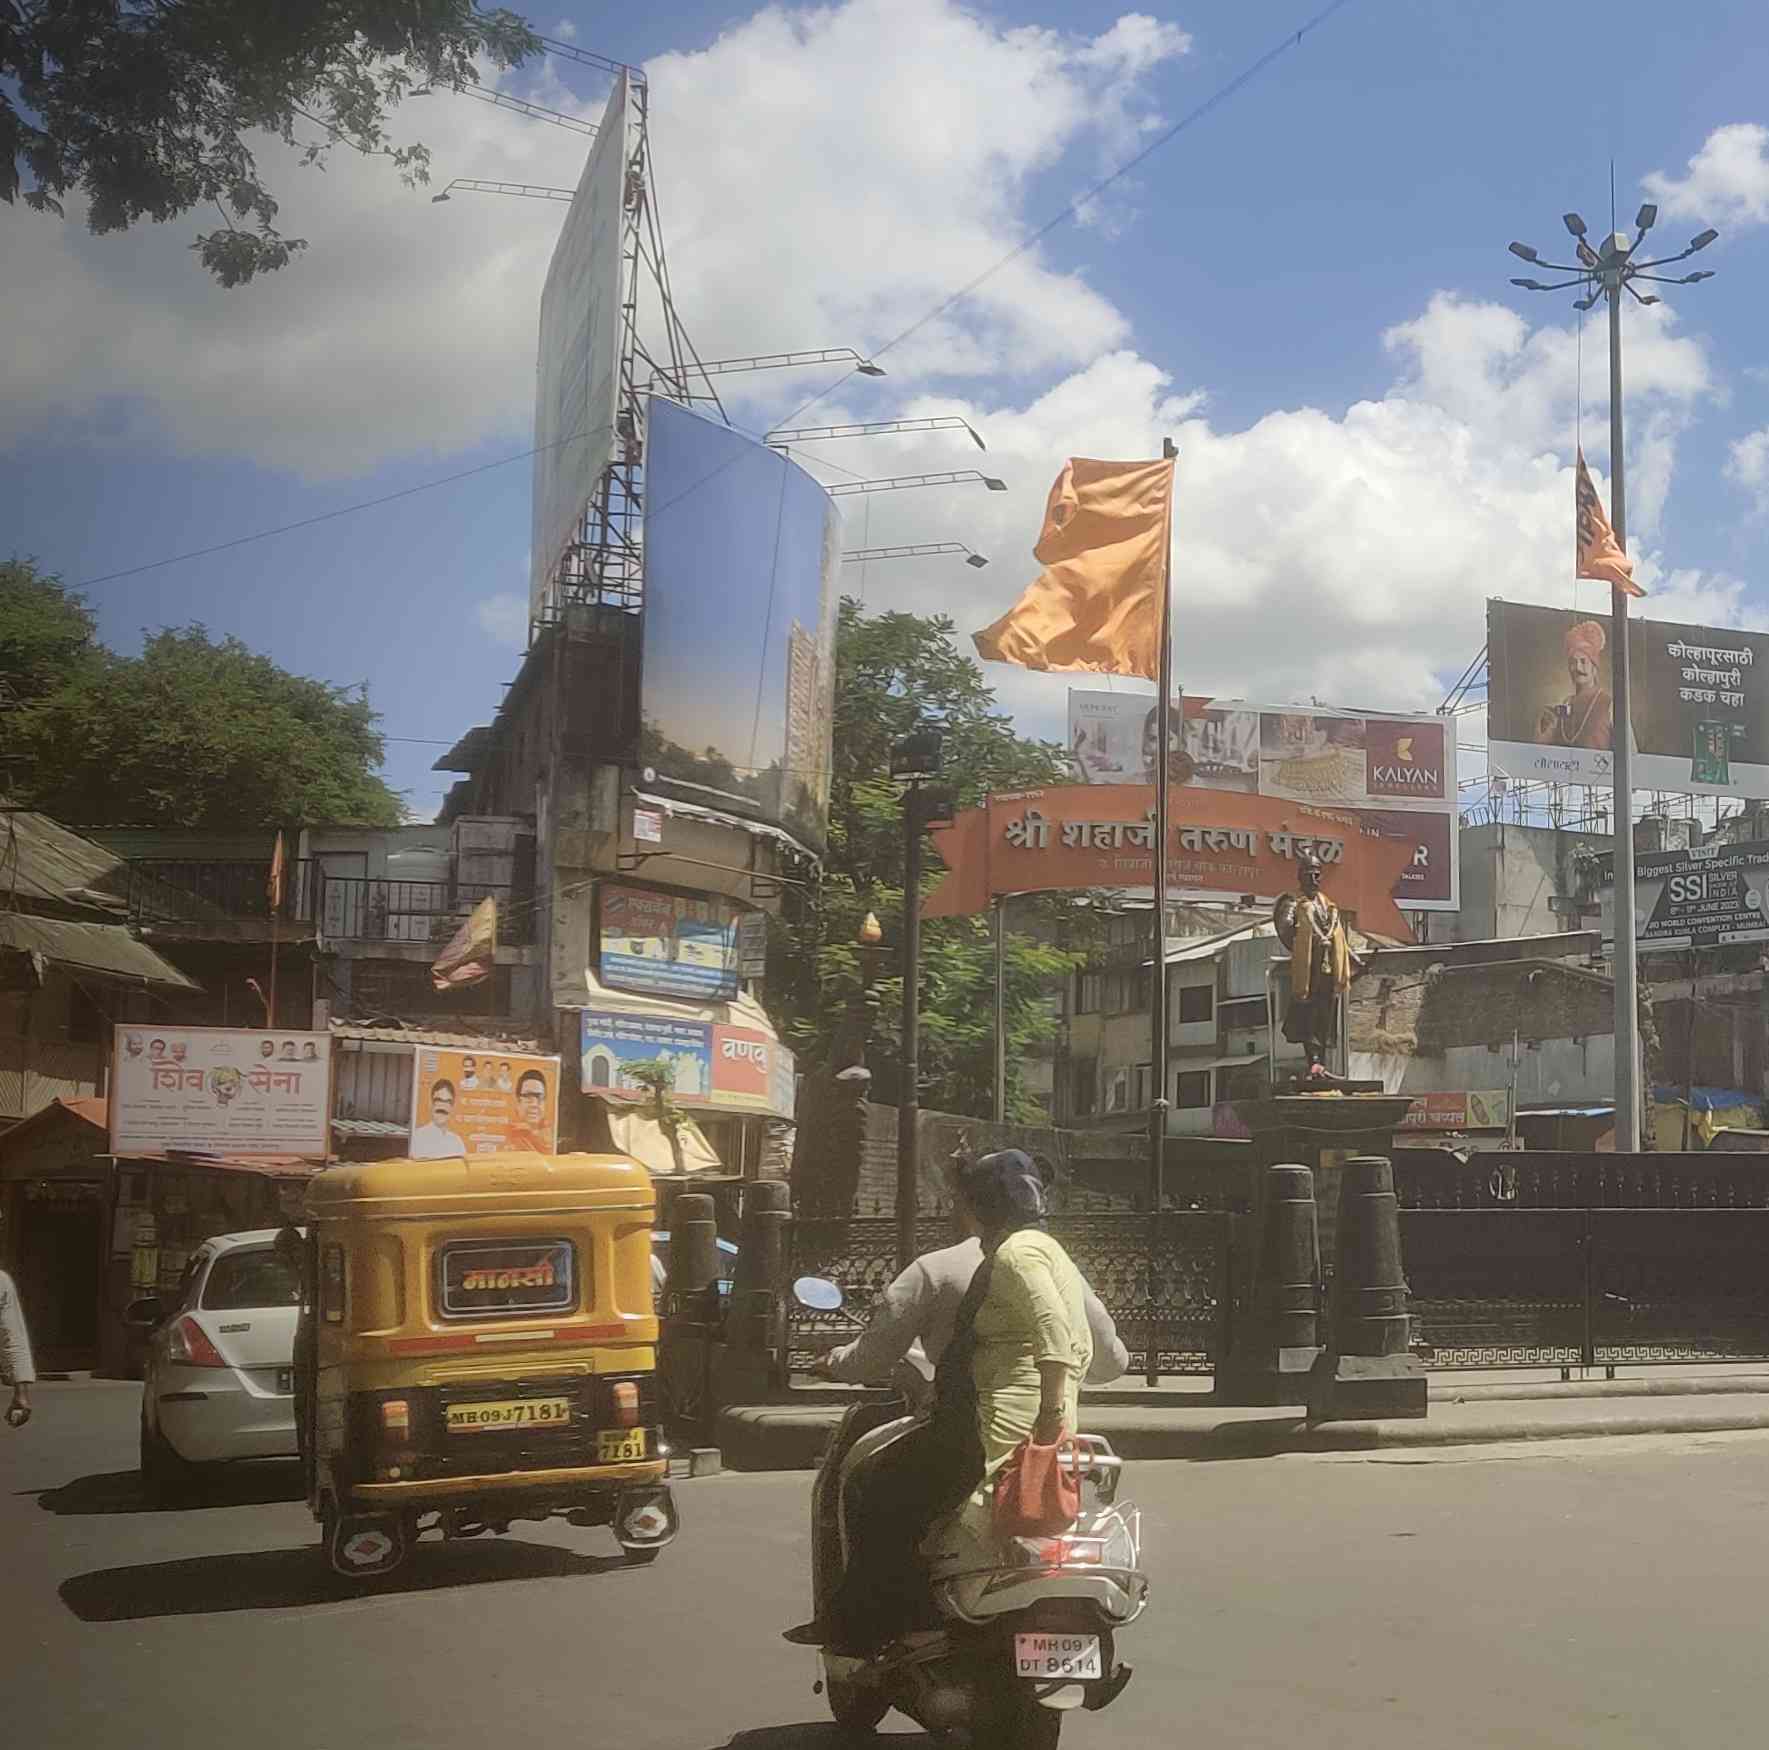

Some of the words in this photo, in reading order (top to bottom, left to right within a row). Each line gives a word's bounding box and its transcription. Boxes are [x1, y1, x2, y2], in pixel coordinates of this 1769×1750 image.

[1666, 640, 1753, 666] कोल्हापूरसाठी
[1680, 663, 1741, 688] कोल्हापुरी
[1678, 687, 1717, 703] कडक
[1719, 690, 1745, 707] चहा
[1373, 766, 1438, 785] KALYAN
[1006, 808, 1050, 848] श्री
[1178, 825, 1258, 857] तरुण
[1636, 865, 1673, 879] Biggest
[1675, 861, 1703, 873] Silver
[1704, 855, 1745, 871] Specific
[1709, 871, 1738, 882] SILVER
[1669, 876, 1708, 902] SSI
[1698, 903, 1719, 912] JUNE
[1720, 900, 1740, 910] 2023
[1661, 919, 1686, 928] WORLD
[1686, 915, 1733, 926] CONVENTION
[1734, 912, 1761, 921] CENTRE
[1698, 923, 1731, 933] COMPLEX
[149, 1057, 204, 1092] शिव
[247, 1063, 302, 1095] सेना
